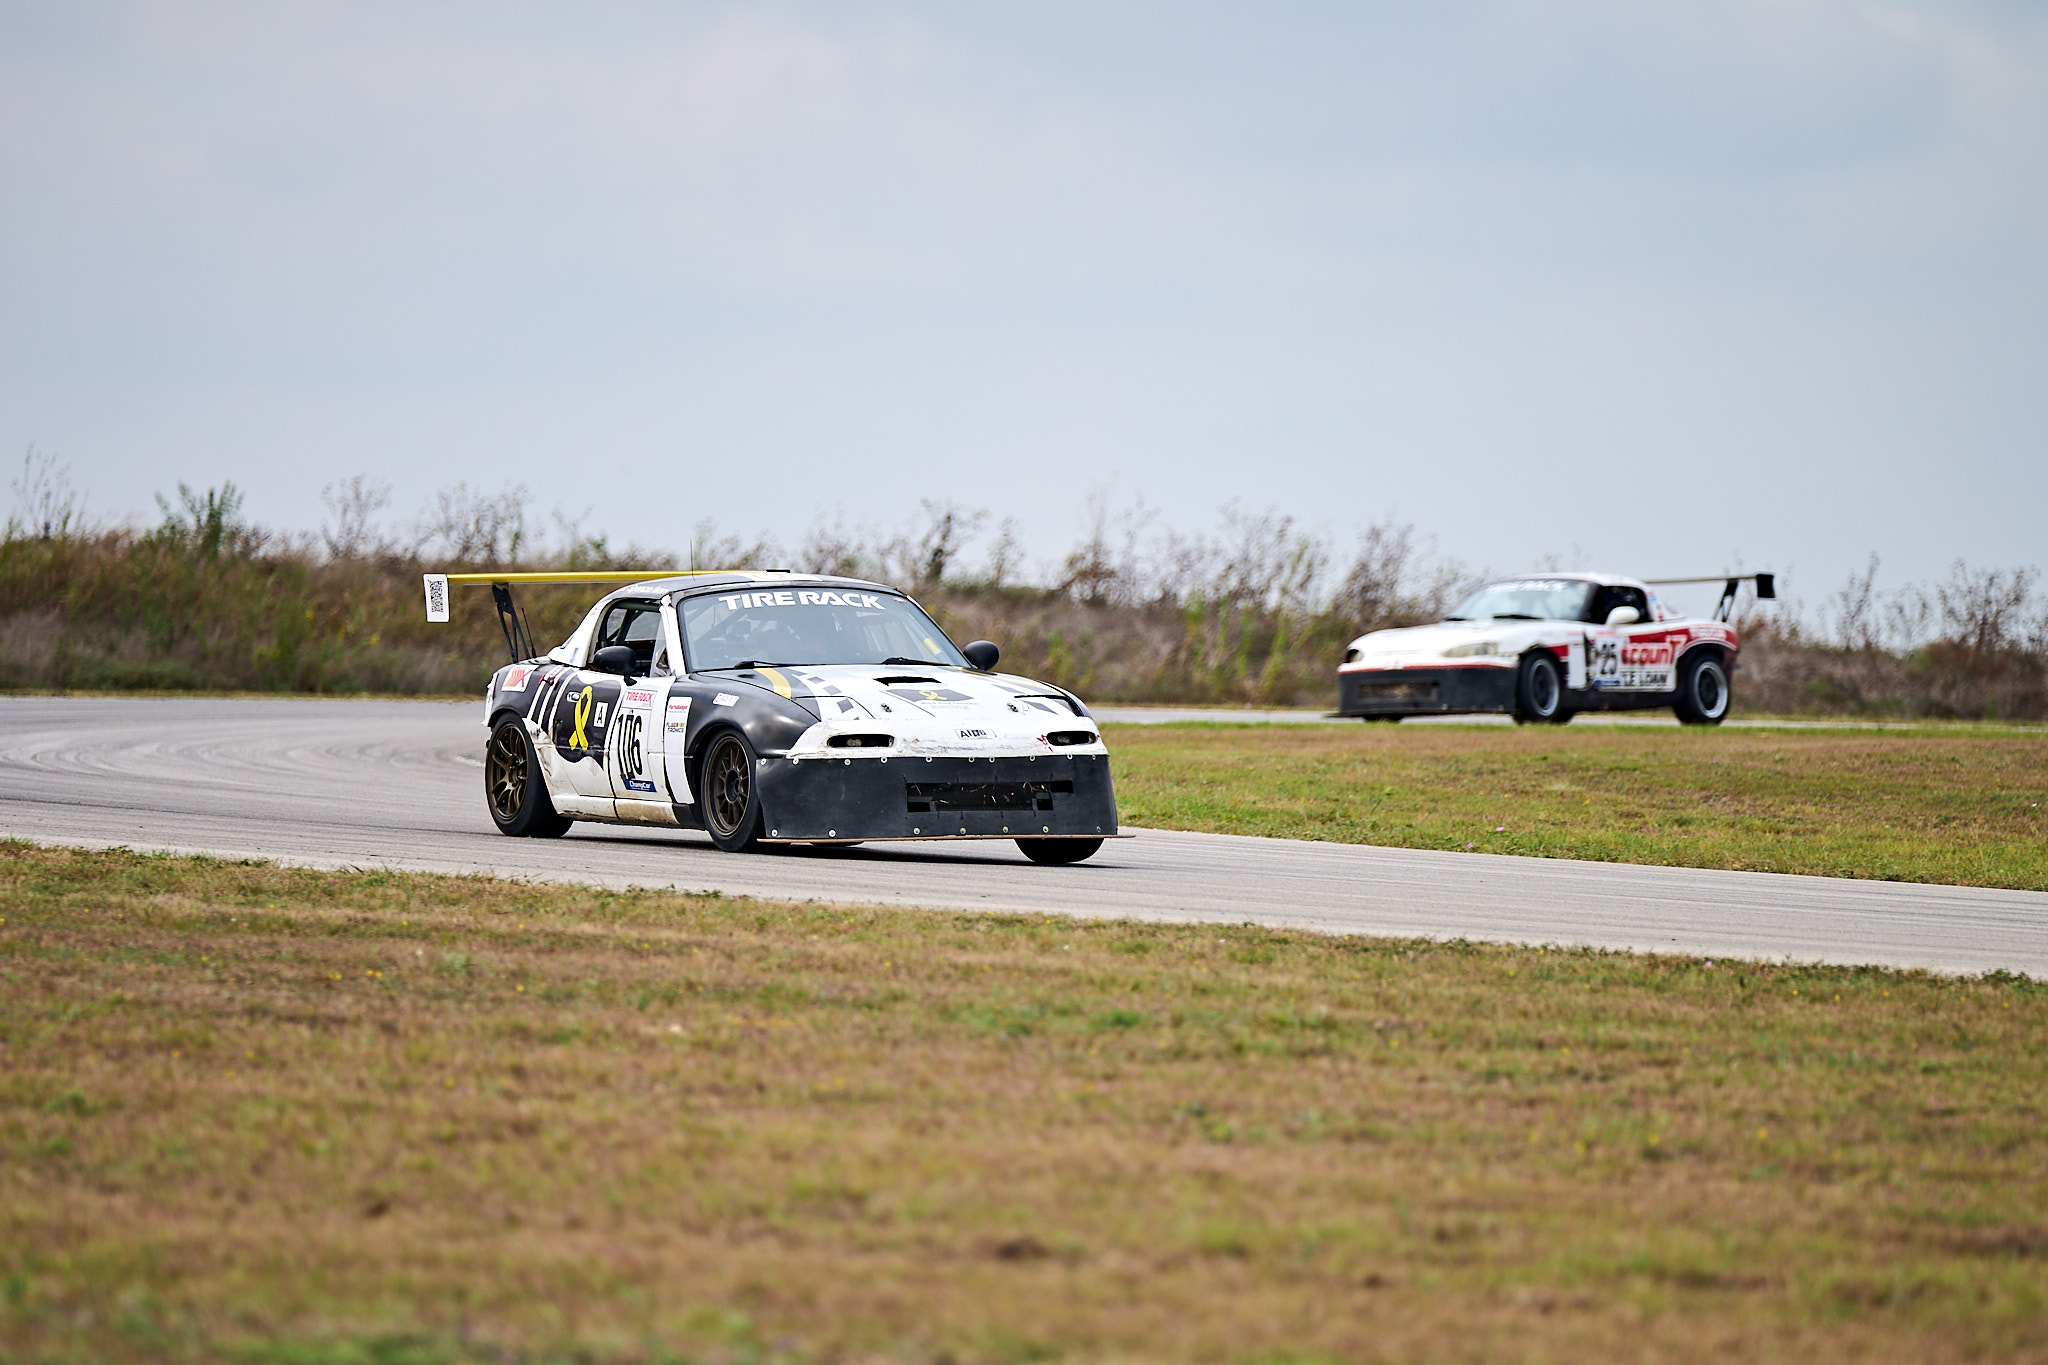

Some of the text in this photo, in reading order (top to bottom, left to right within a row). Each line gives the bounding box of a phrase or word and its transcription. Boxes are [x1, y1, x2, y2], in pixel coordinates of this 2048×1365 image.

[718, 591, 886, 611] TIRE RACK
[626, 691, 655, 708] TIRE RACK
[596, 705, 604, 724] A
